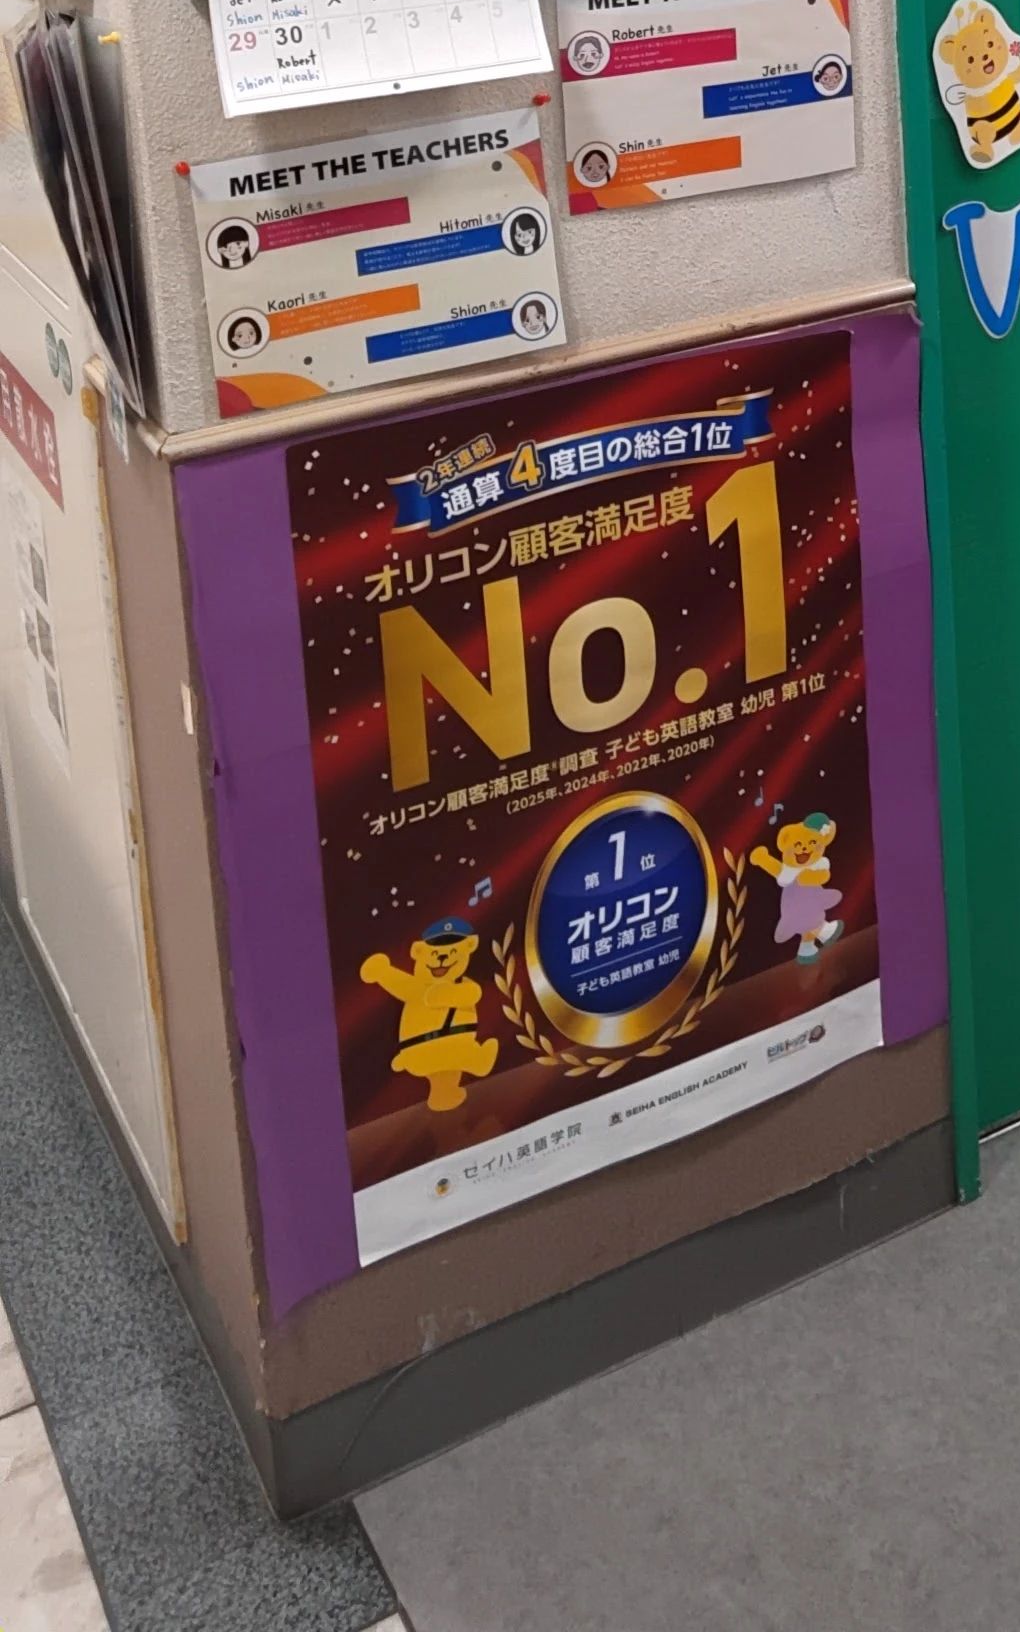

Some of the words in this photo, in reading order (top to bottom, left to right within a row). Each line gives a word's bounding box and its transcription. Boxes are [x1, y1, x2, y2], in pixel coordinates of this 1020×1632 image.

[228, 31, 257, 51] 29
[275, 25, 302, 45] 30
[612, 25, 655, 41] Robert
[762, 65, 782, 77] Jet
[230, 164, 305, 197] MEET
[312, 153, 368, 180] THE
[373, 129, 510, 170] TEACHERS
[619, 140, 645, 153] Shin
[256, 202, 303, 223] Misaki
[439, 215, 483, 233] Hitomi
[267, 293, 305, 312] Kaori
[308, 291, 327, 300] 先生
[451, 304, 487, 319] Shion
[489, 299, 508, 310] 先生
[418, 436, 493, 492] 2年連続
[441, 420, 732, 519] 通算4度目の総合1位
[364, 485, 695, 604] オリコン顧客満足度
[379, 461, 787, 792] No.1
[605, 702, 734, 760] 子ども英語教室
[740, 688, 776, 716] 幼児
[781, 673, 826, 706] 第1位
[567, 885, 679, 943] オリコン
[570, 914, 680, 963] 顧客満足度
[576, 962, 655, 997] 子ども英語教室
[658, 950, 680, 967] 幼児
[625, 1101, 656, 1118] SEIHA
[658, 1082, 700, 1105] ENGLISH
[702, 1061, 749, 1087] ACADEMY
[463, 1122, 582, 1179] セイハ英語学院
